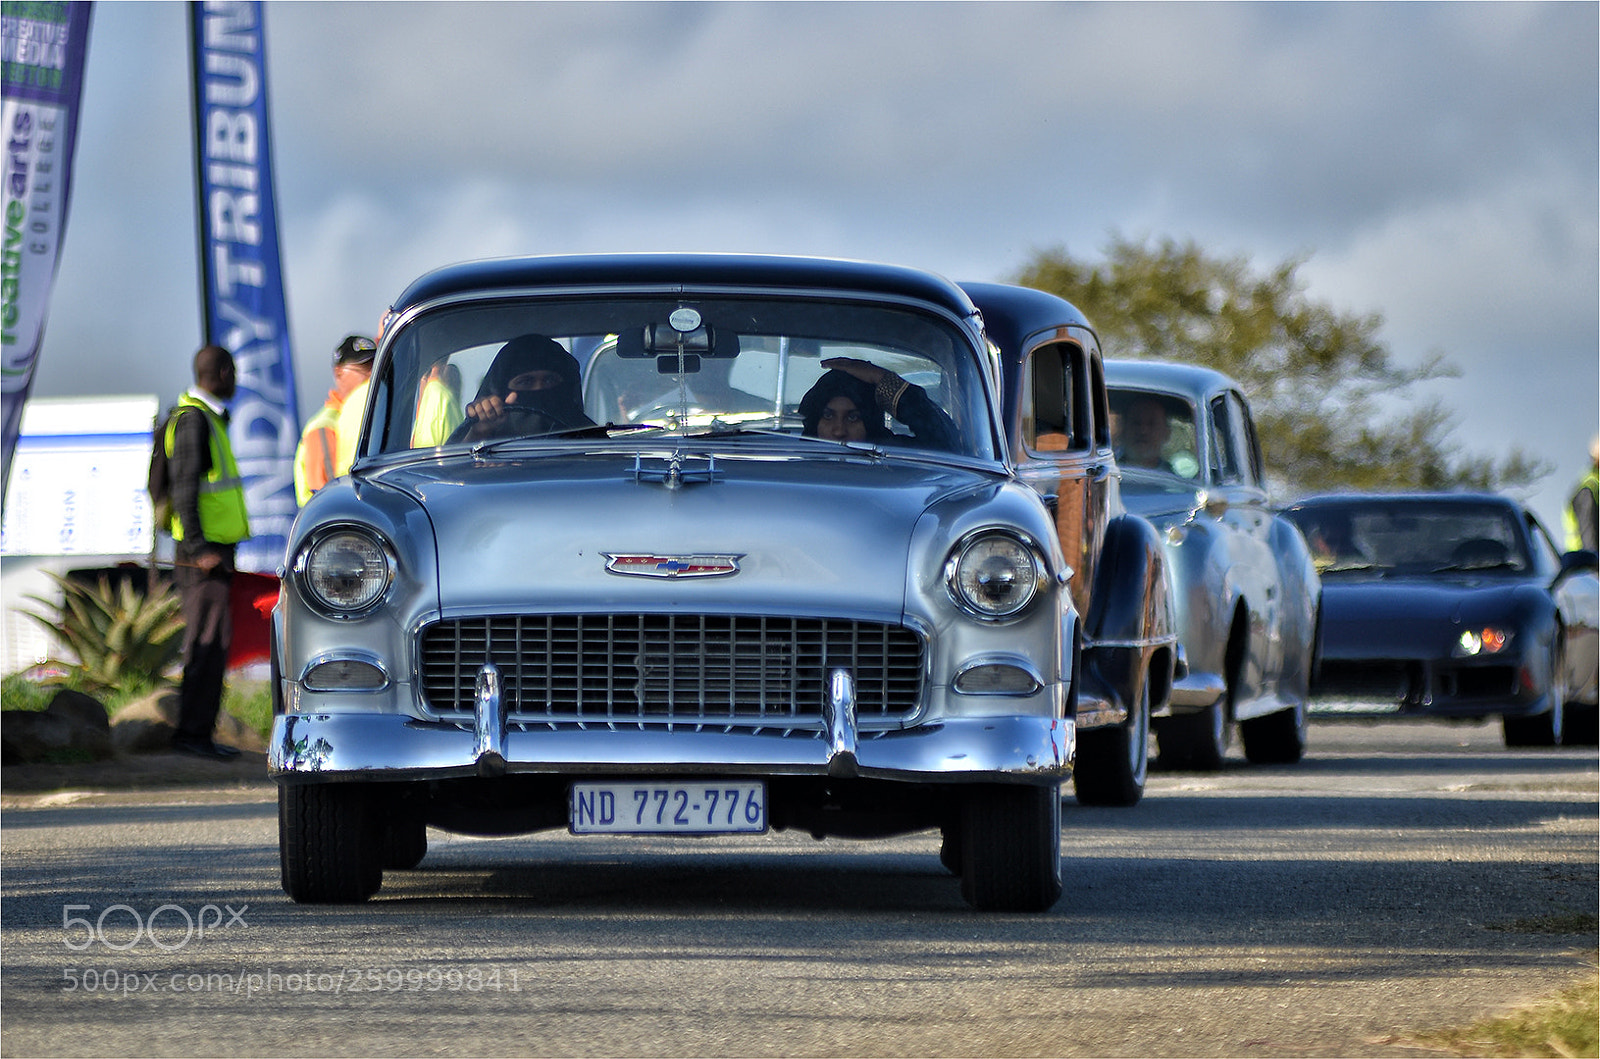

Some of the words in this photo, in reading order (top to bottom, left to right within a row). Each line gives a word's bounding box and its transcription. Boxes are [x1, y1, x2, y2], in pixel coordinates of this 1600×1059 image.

[29, 120, 55, 255] COLLEGE
[579, 791, 615, 826] ND
[634, 789, 760, 825] 772-776
